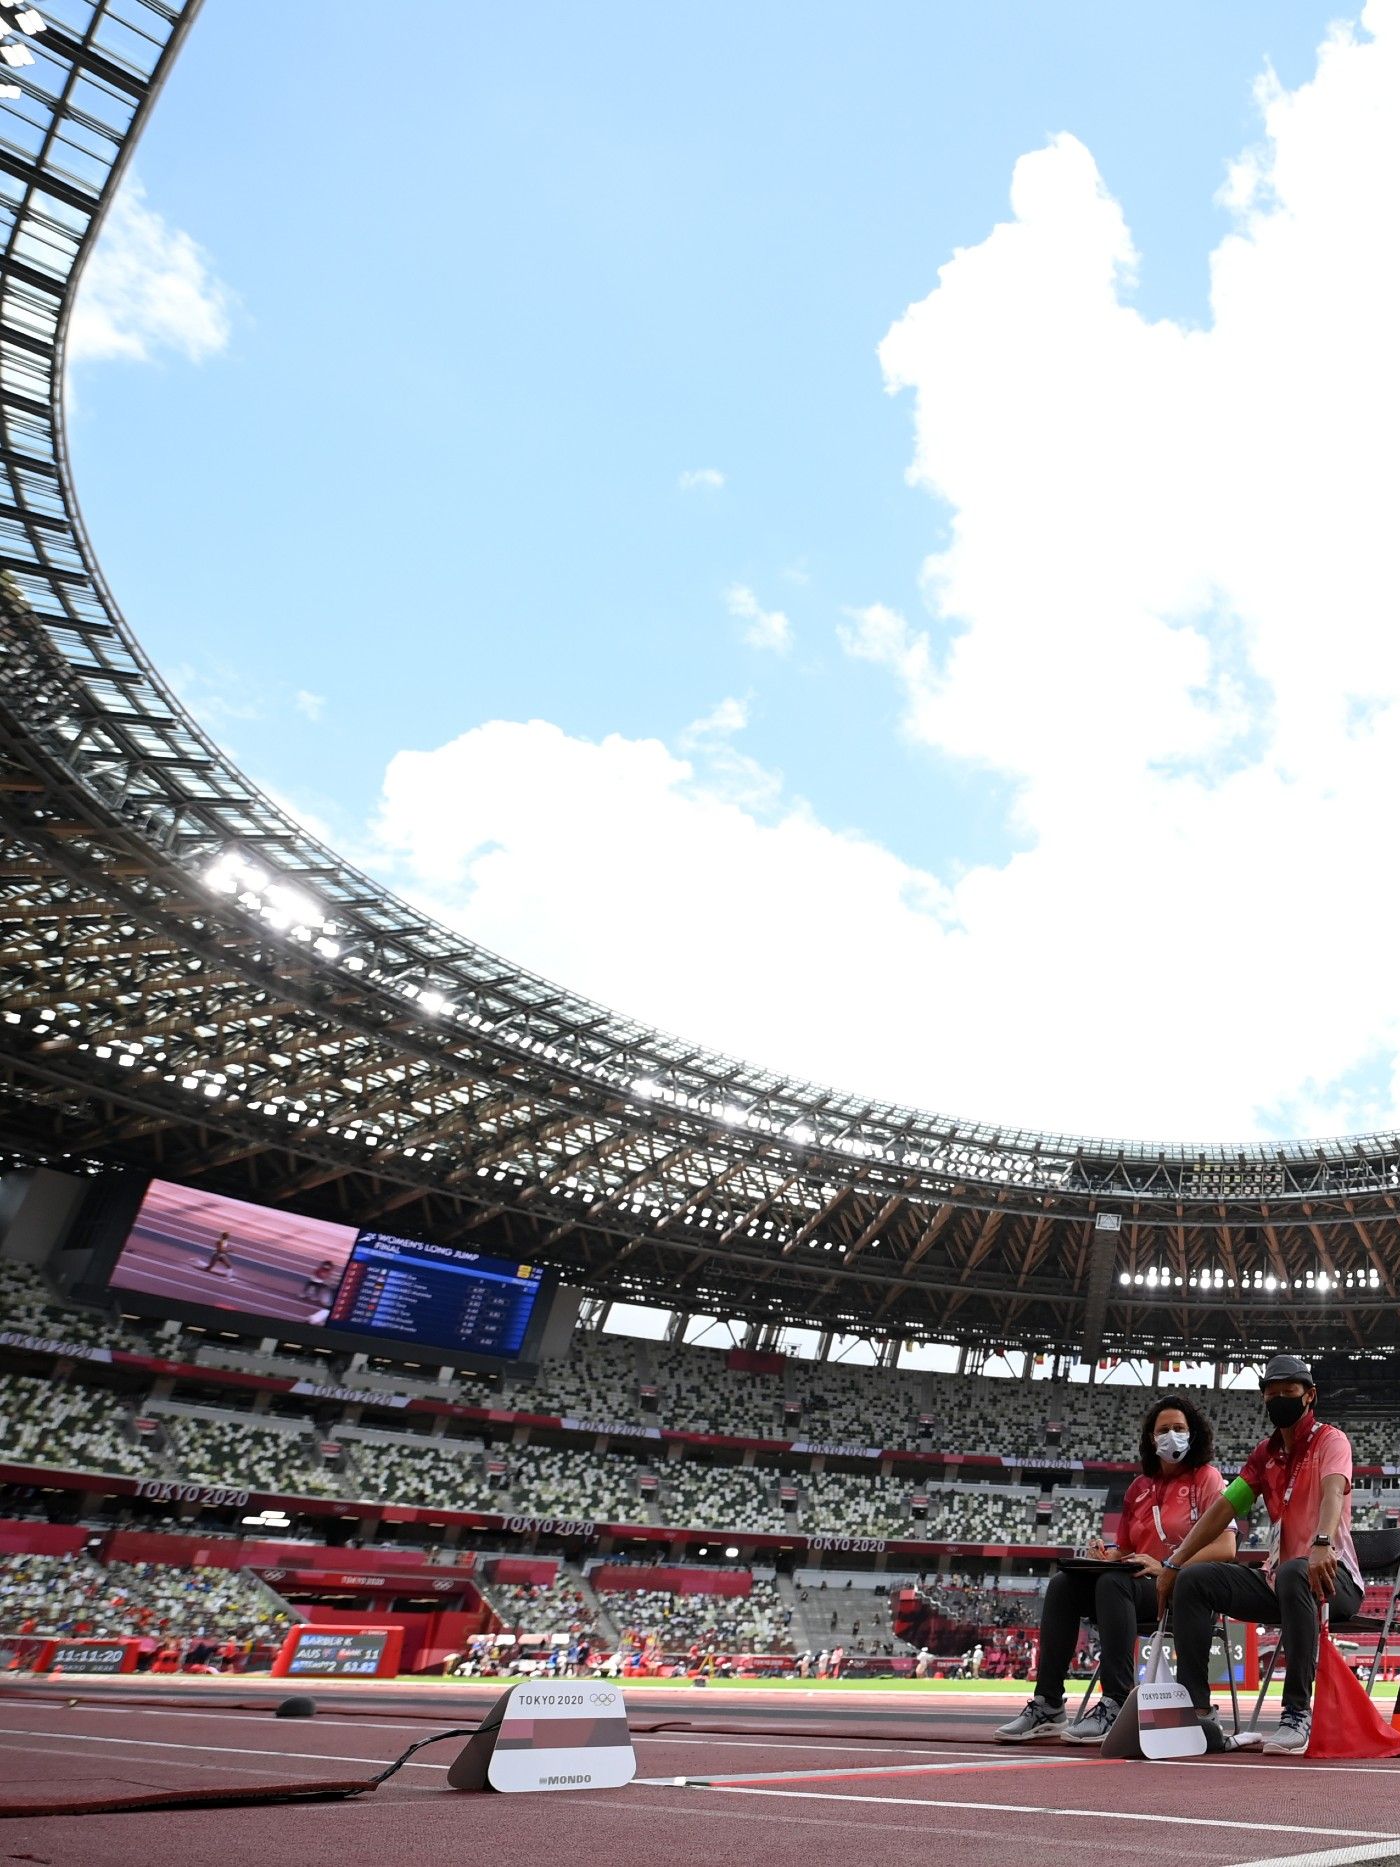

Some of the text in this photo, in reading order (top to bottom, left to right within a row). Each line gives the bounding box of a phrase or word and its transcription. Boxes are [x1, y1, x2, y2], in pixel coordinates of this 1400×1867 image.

[374, 1242, 401, 1254] FINAL
[378, 1234, 480, 1262] WOMEN'S LONG JUMP
[577, 1421, 646, 1436] TOKYO 2020
[806, 1445, 867, 1457] TOKYO 2020
[1014, 1459, 1071, 1469] TOKYO 2020
[134, 1479, 250, 1506] TOKYO 2020
[501, 1515, 595, 1536] TOKYO 2020
[806, 1536, 885, 1553] TOKYO 2020
[296, 1648, 322, 1659] AUS
[364, 1649, 380, 1660] 11
[1141, 1644, 1243, 1660] GR 3
[519, 1695, 584, 1705] TOKYO 2020
[548, 1775, 592, 1785] MONDO
